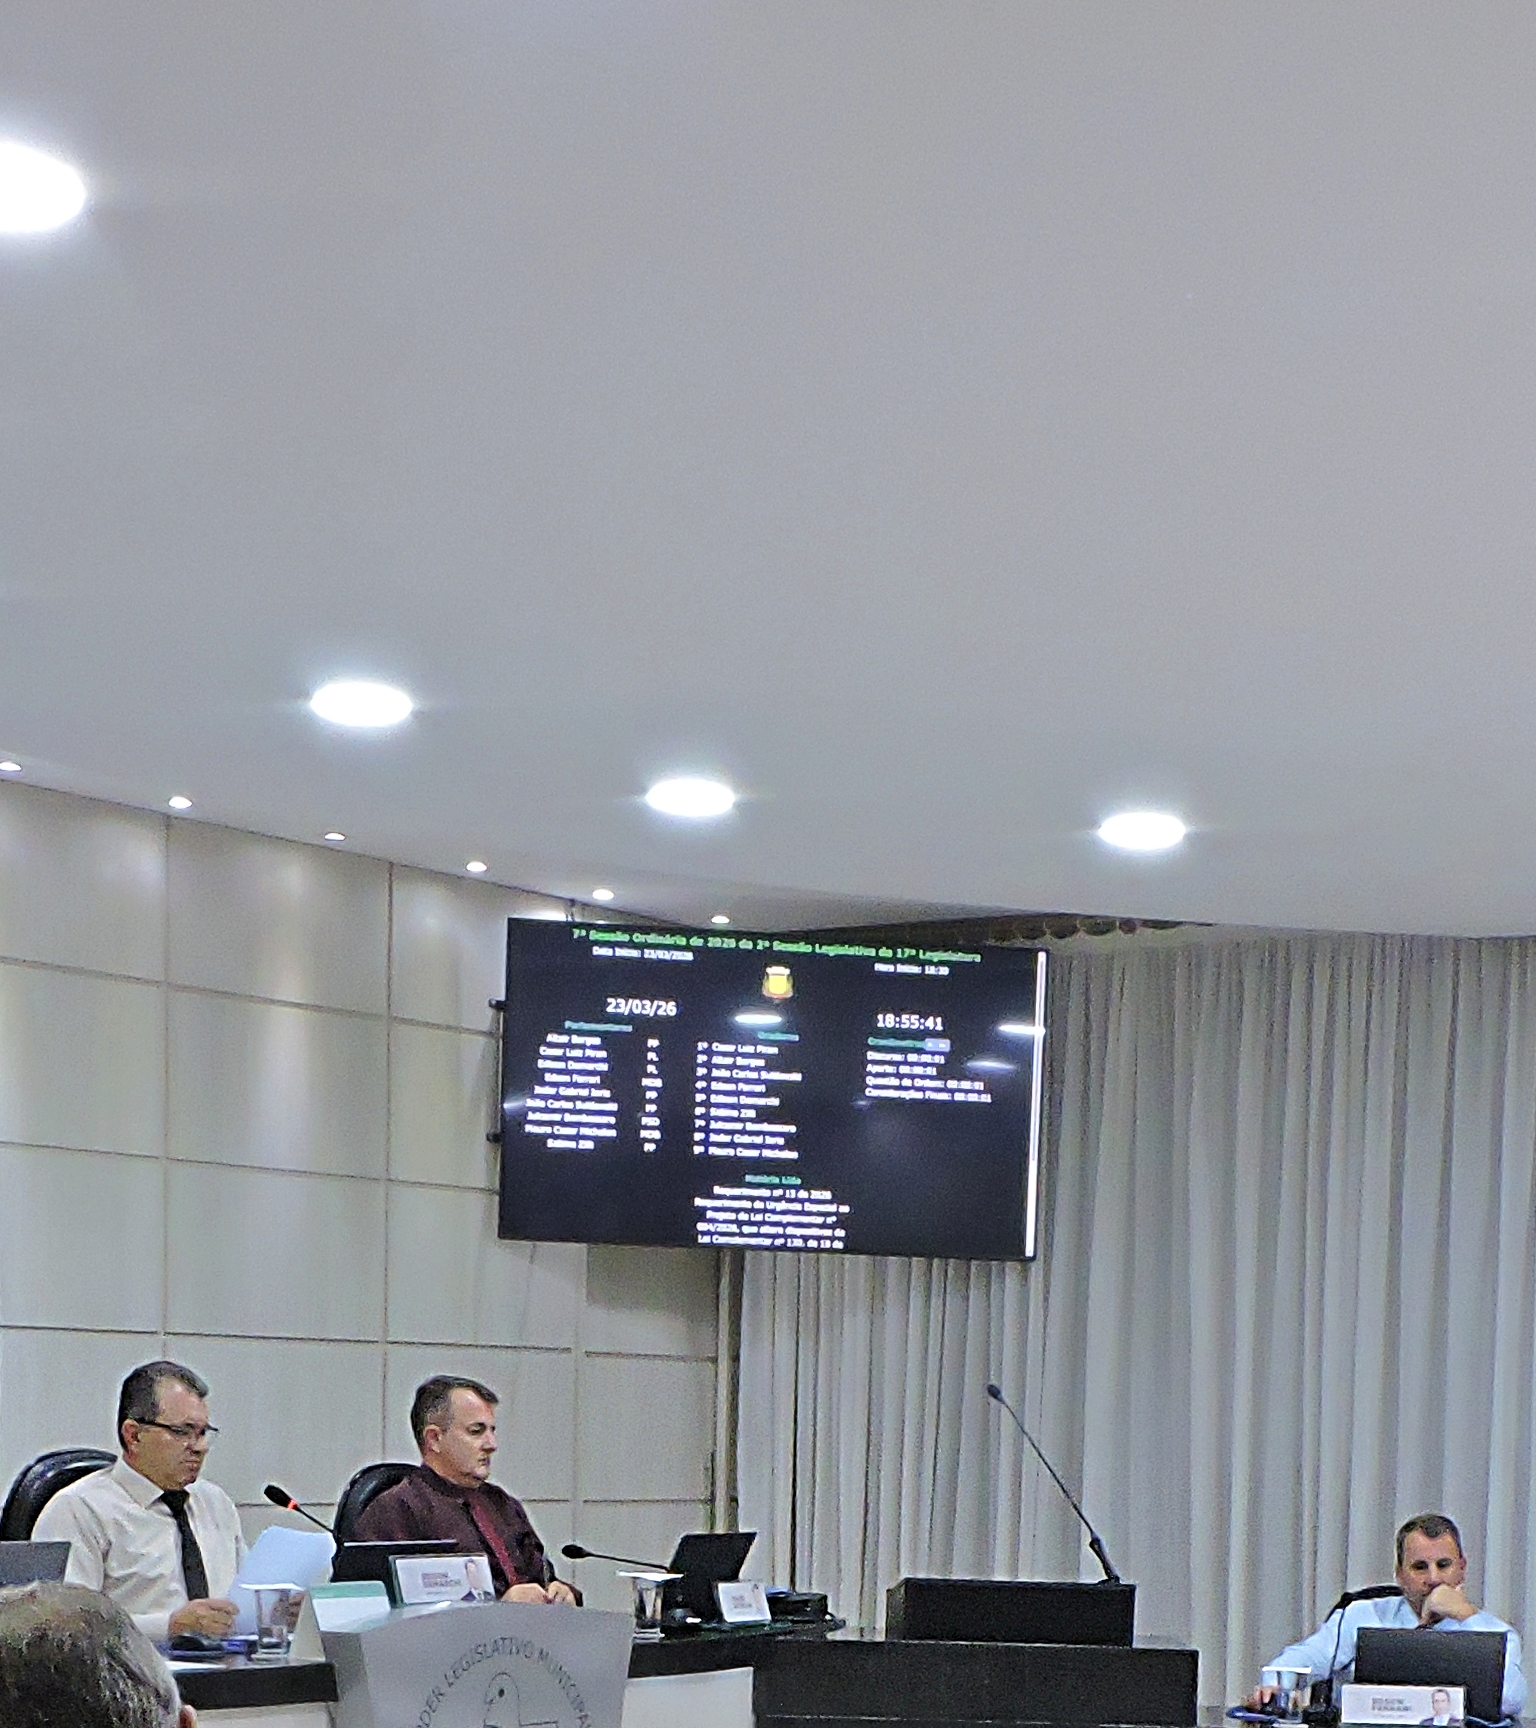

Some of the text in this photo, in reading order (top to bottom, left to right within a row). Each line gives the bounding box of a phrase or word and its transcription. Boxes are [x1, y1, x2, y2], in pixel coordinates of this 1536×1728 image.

[606, 997, 677, 1017] 23/03/26
[876, 1013, 943, 1031] 18:55:41
[444, 1635, 534, 1689] LEGISLATIVO
